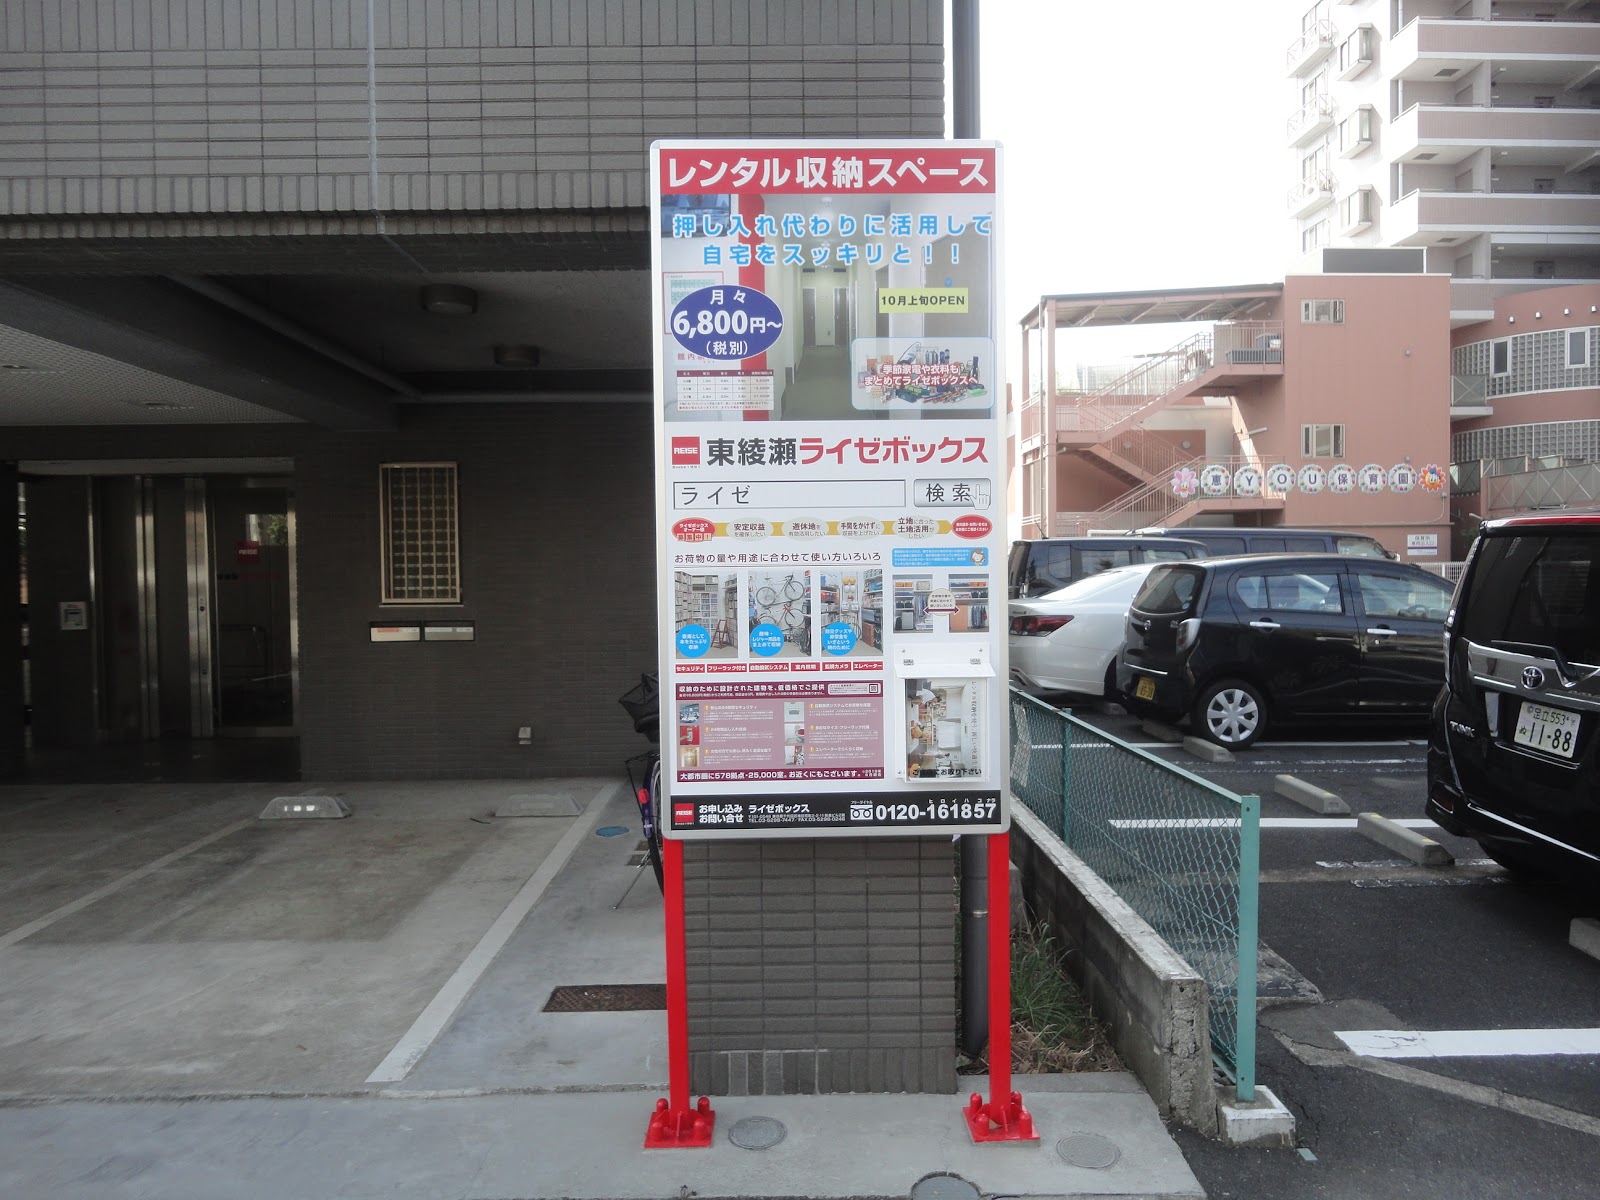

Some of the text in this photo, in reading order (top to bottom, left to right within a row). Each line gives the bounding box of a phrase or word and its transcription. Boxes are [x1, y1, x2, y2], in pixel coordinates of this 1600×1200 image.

[668, 156, 989, 188] レンタル収納スペース
[673, 213, 992, 237] 押し入れ代わりに活用して
[710, 289, 746, 305] 月々
[881, 295, 965, 306] 10月上旬OPEN
[706, 340, 748, 356] (税別)
[864, 376, 978, 387] まとめてライゼボックスへ
[673, 447, 699, 455] REISE
[706, 436, 989, 467] 東綾瀬ライゼボックス
[680, 484, 751, 505] ライゼ
[925, 483, 972, 504] 検索
[792, 522, 821, 530] 遊休地を
[897, 517, 934, 525] 立地に合った
[733, 523, 766, 531] 安定収益
[897, 525, 934, 533] 土地活用が
[674, 552, 881, 563] お荷物の量や用途に合わせて使い方いろいろ
[1529, 722, 1572, 752] 11-88
[699, 804, 743, 814] お申し込み
[748, 804, 810, 814] ライゼボックス
[876, 803, 996, 820] 0120-161857
[699, 814, 744, 823] お問い合せ
